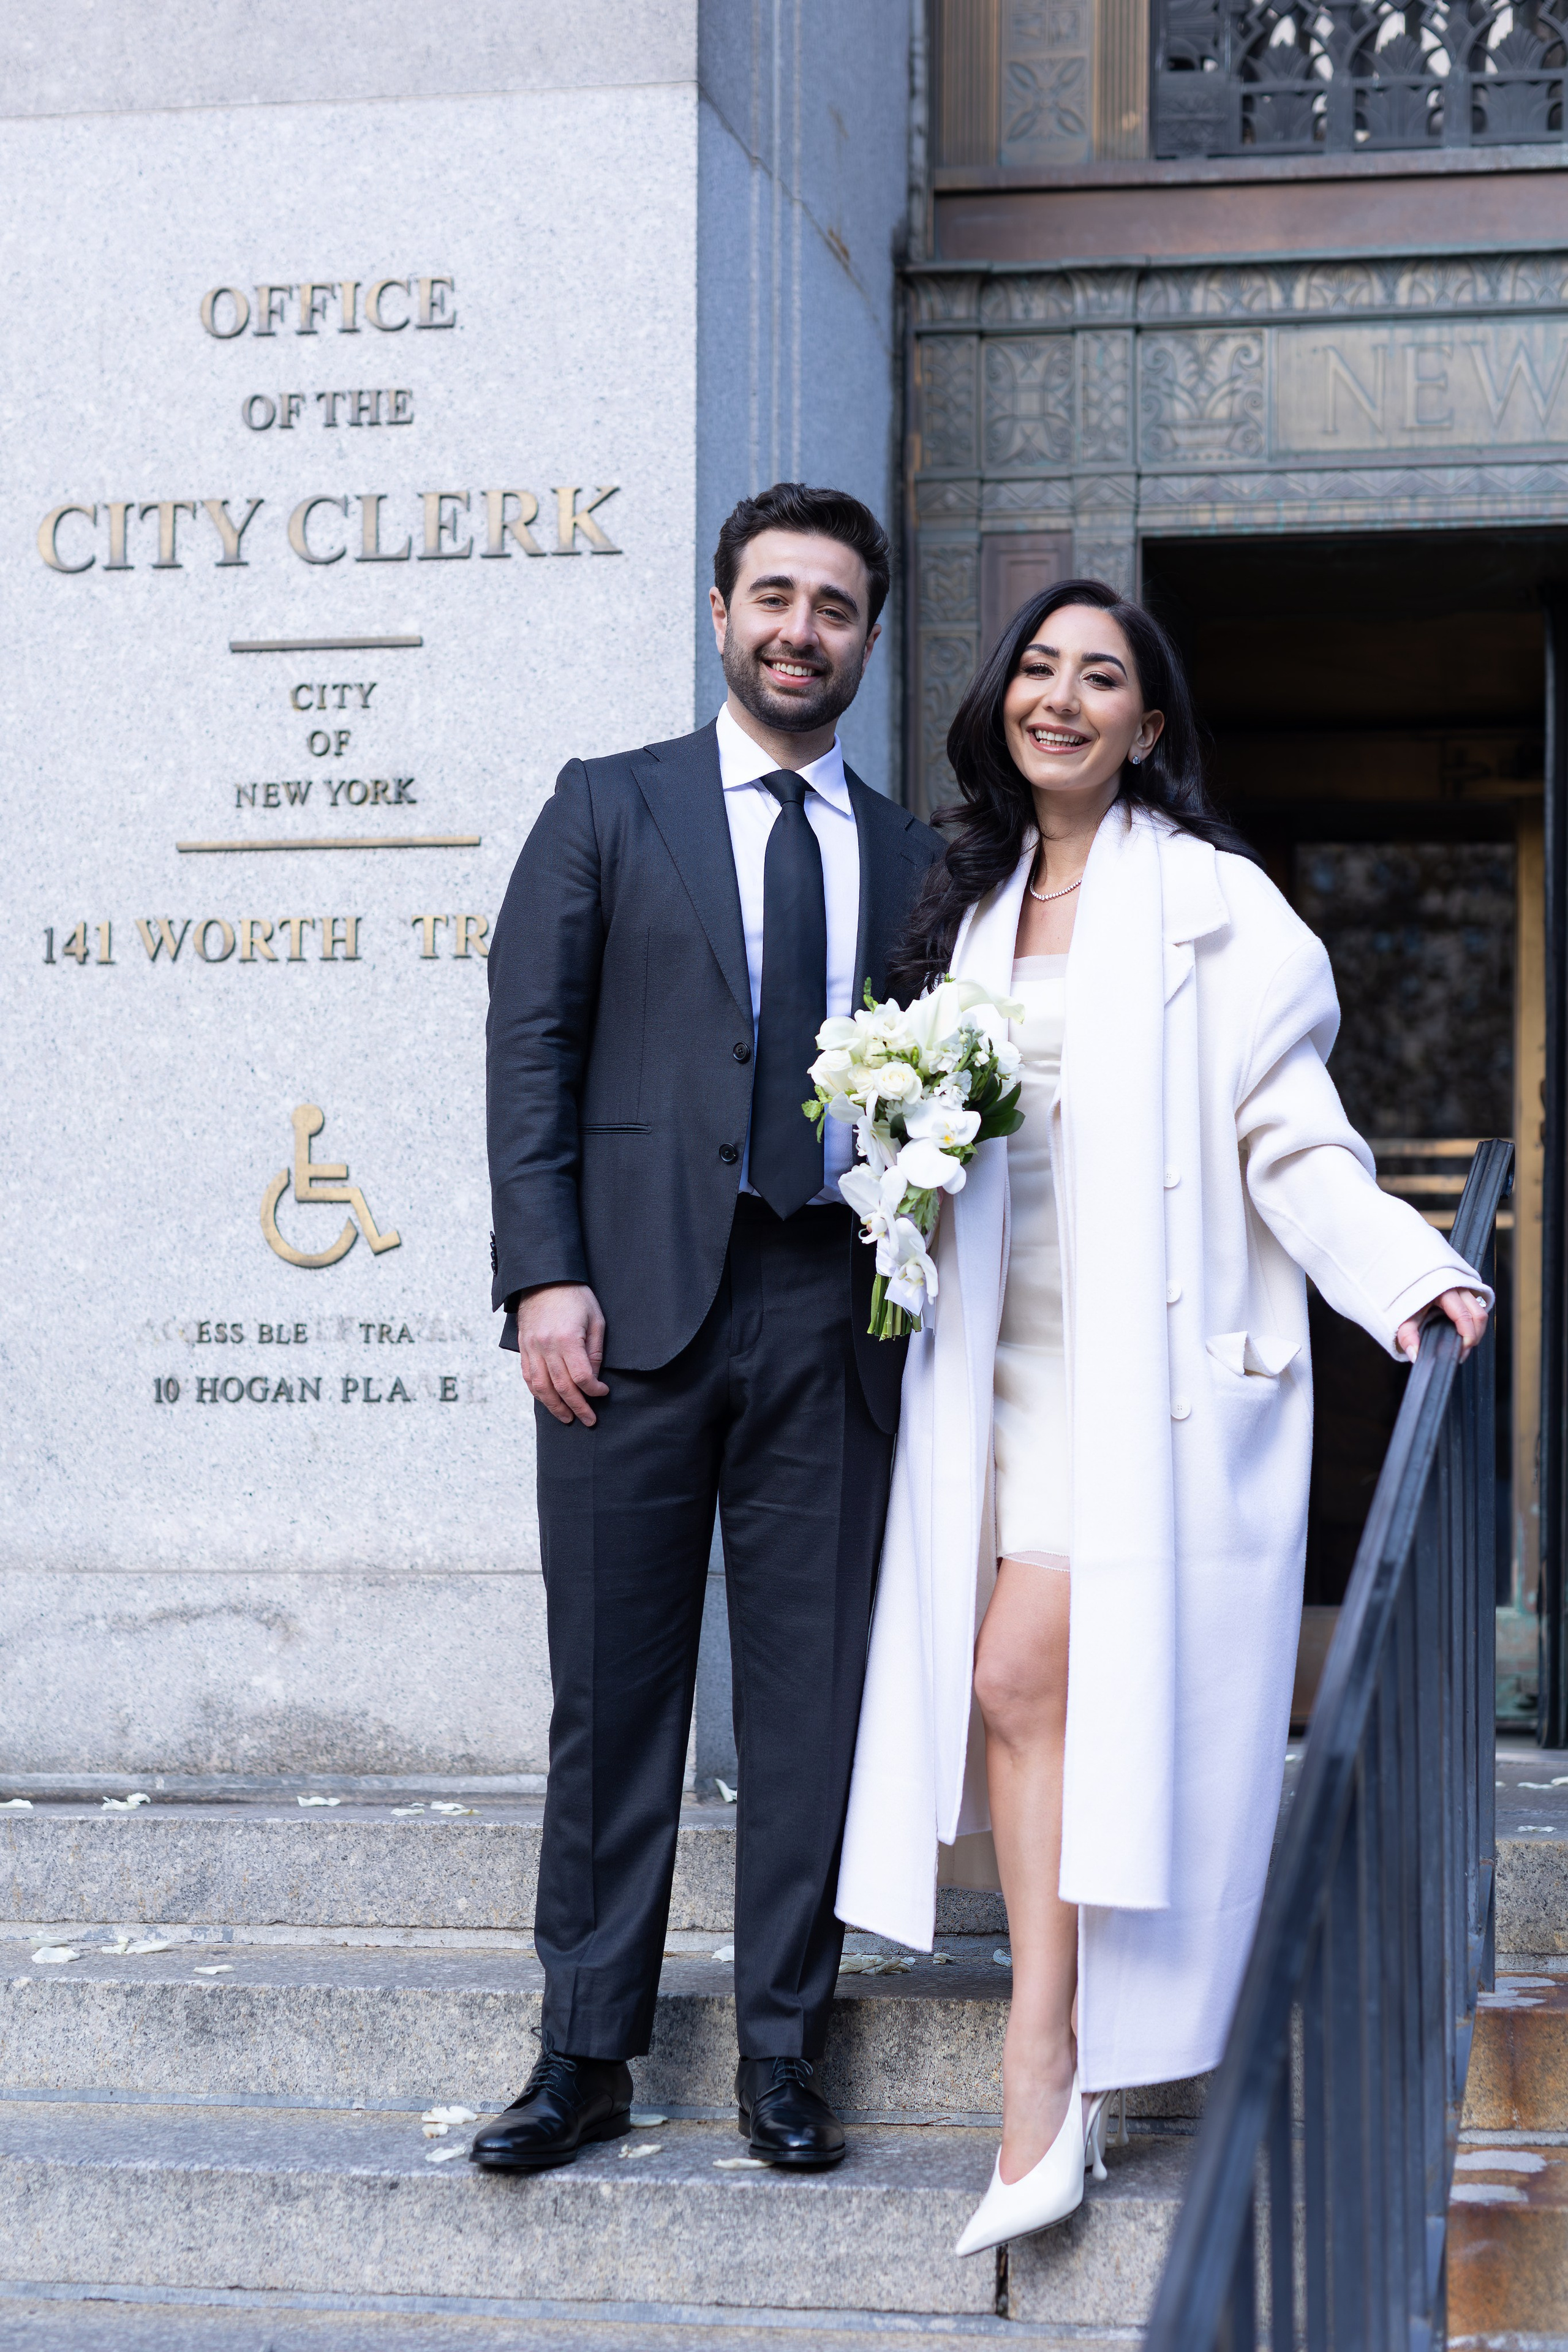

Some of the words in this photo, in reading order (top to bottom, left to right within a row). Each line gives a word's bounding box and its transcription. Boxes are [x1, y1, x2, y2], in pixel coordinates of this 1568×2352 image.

[200, 275, 457, 340] OFFICE
[1318, 337, 1568, 437] NEW
[242, 391, 306, 431] OF
[316, 388, 414, 429] THE
[36, 497, 264, 574] CITY
[287, 486, 624, 565] CLERK
[290, 682, 378, 710] CITY
[306, 729, 352, 758] OF
[235, 780, 313, 809] NEW
[327, 777, 418, 806] YORK
[43, 920, 116, 966] 141
[135, 916, 363, 963] WORTH
[154, 1376, 180, 1404] 10
[195, 1376, 323, 1403] HOGAN
